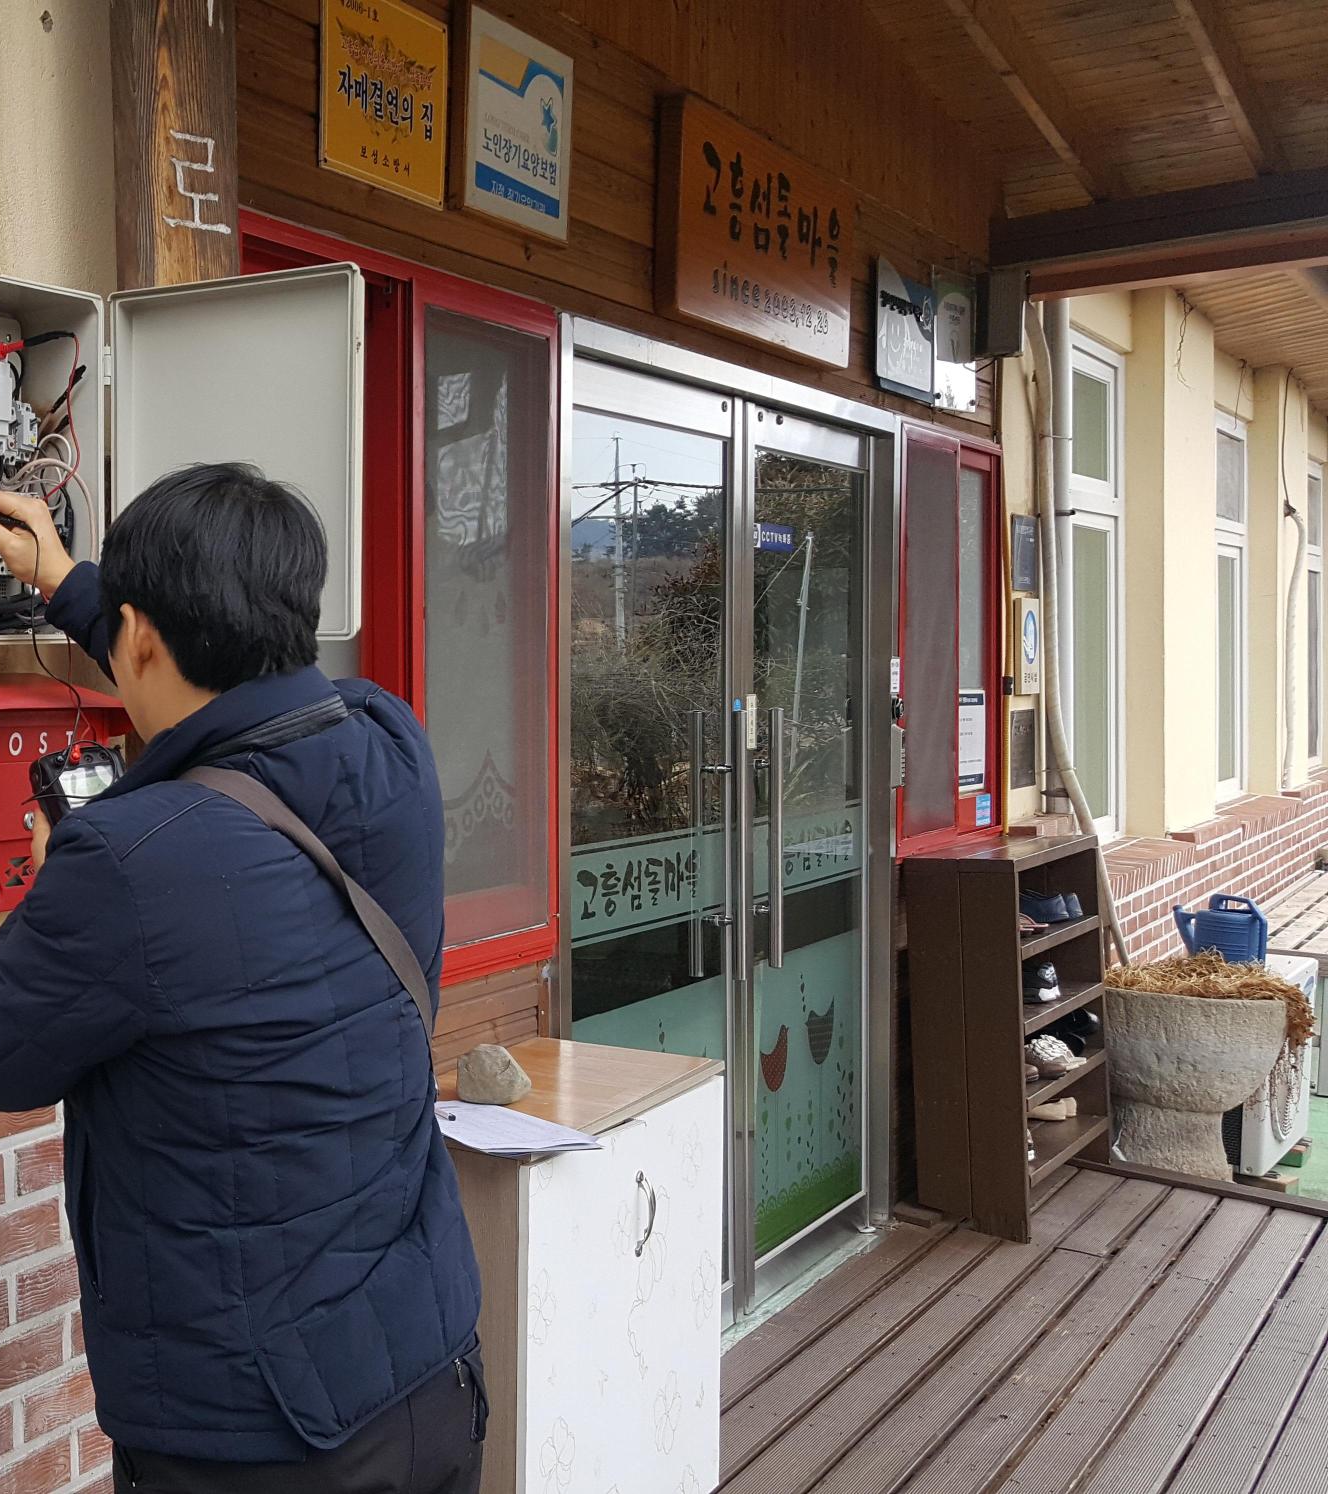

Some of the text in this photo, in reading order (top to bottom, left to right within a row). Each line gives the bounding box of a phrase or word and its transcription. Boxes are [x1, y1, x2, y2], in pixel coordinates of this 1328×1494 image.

[337, 64, 413, 133] 자매결연의
[420, 102, 433, 141] 집
[482, 127, 557, 186] 노인장기요양보험
[702, 141, 840, 288] 고흥섬돌마을
[577, 849, 698, 920] 고흥섬돌마을
